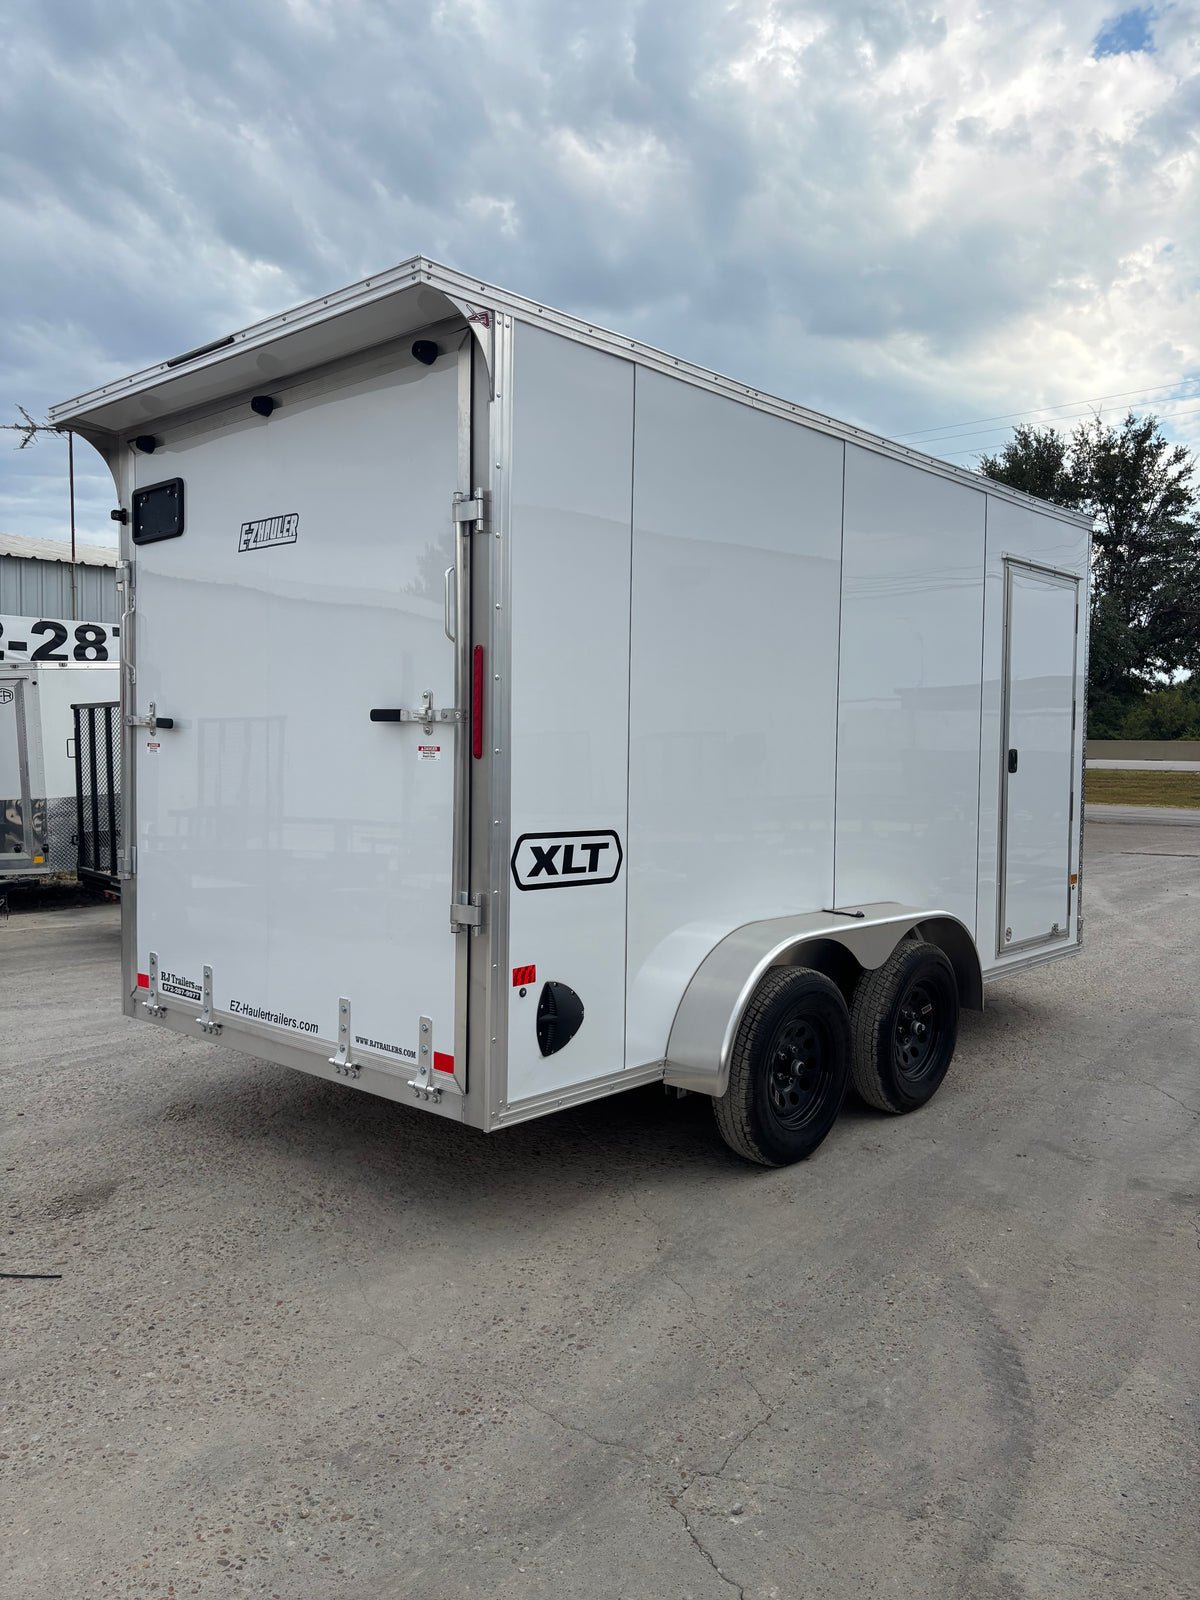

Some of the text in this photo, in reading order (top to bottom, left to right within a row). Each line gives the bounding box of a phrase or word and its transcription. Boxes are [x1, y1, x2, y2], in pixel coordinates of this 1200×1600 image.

[0, 621, 120, 661] -28
[527, 842, 609, 877] XLT
[161, 971, 171, 982] RJ
[229, 999, 319, 1033] EZ-Haulertrailers.com
[355, 1035, 417, 1059] WWW.RJTRAILERS.COM
